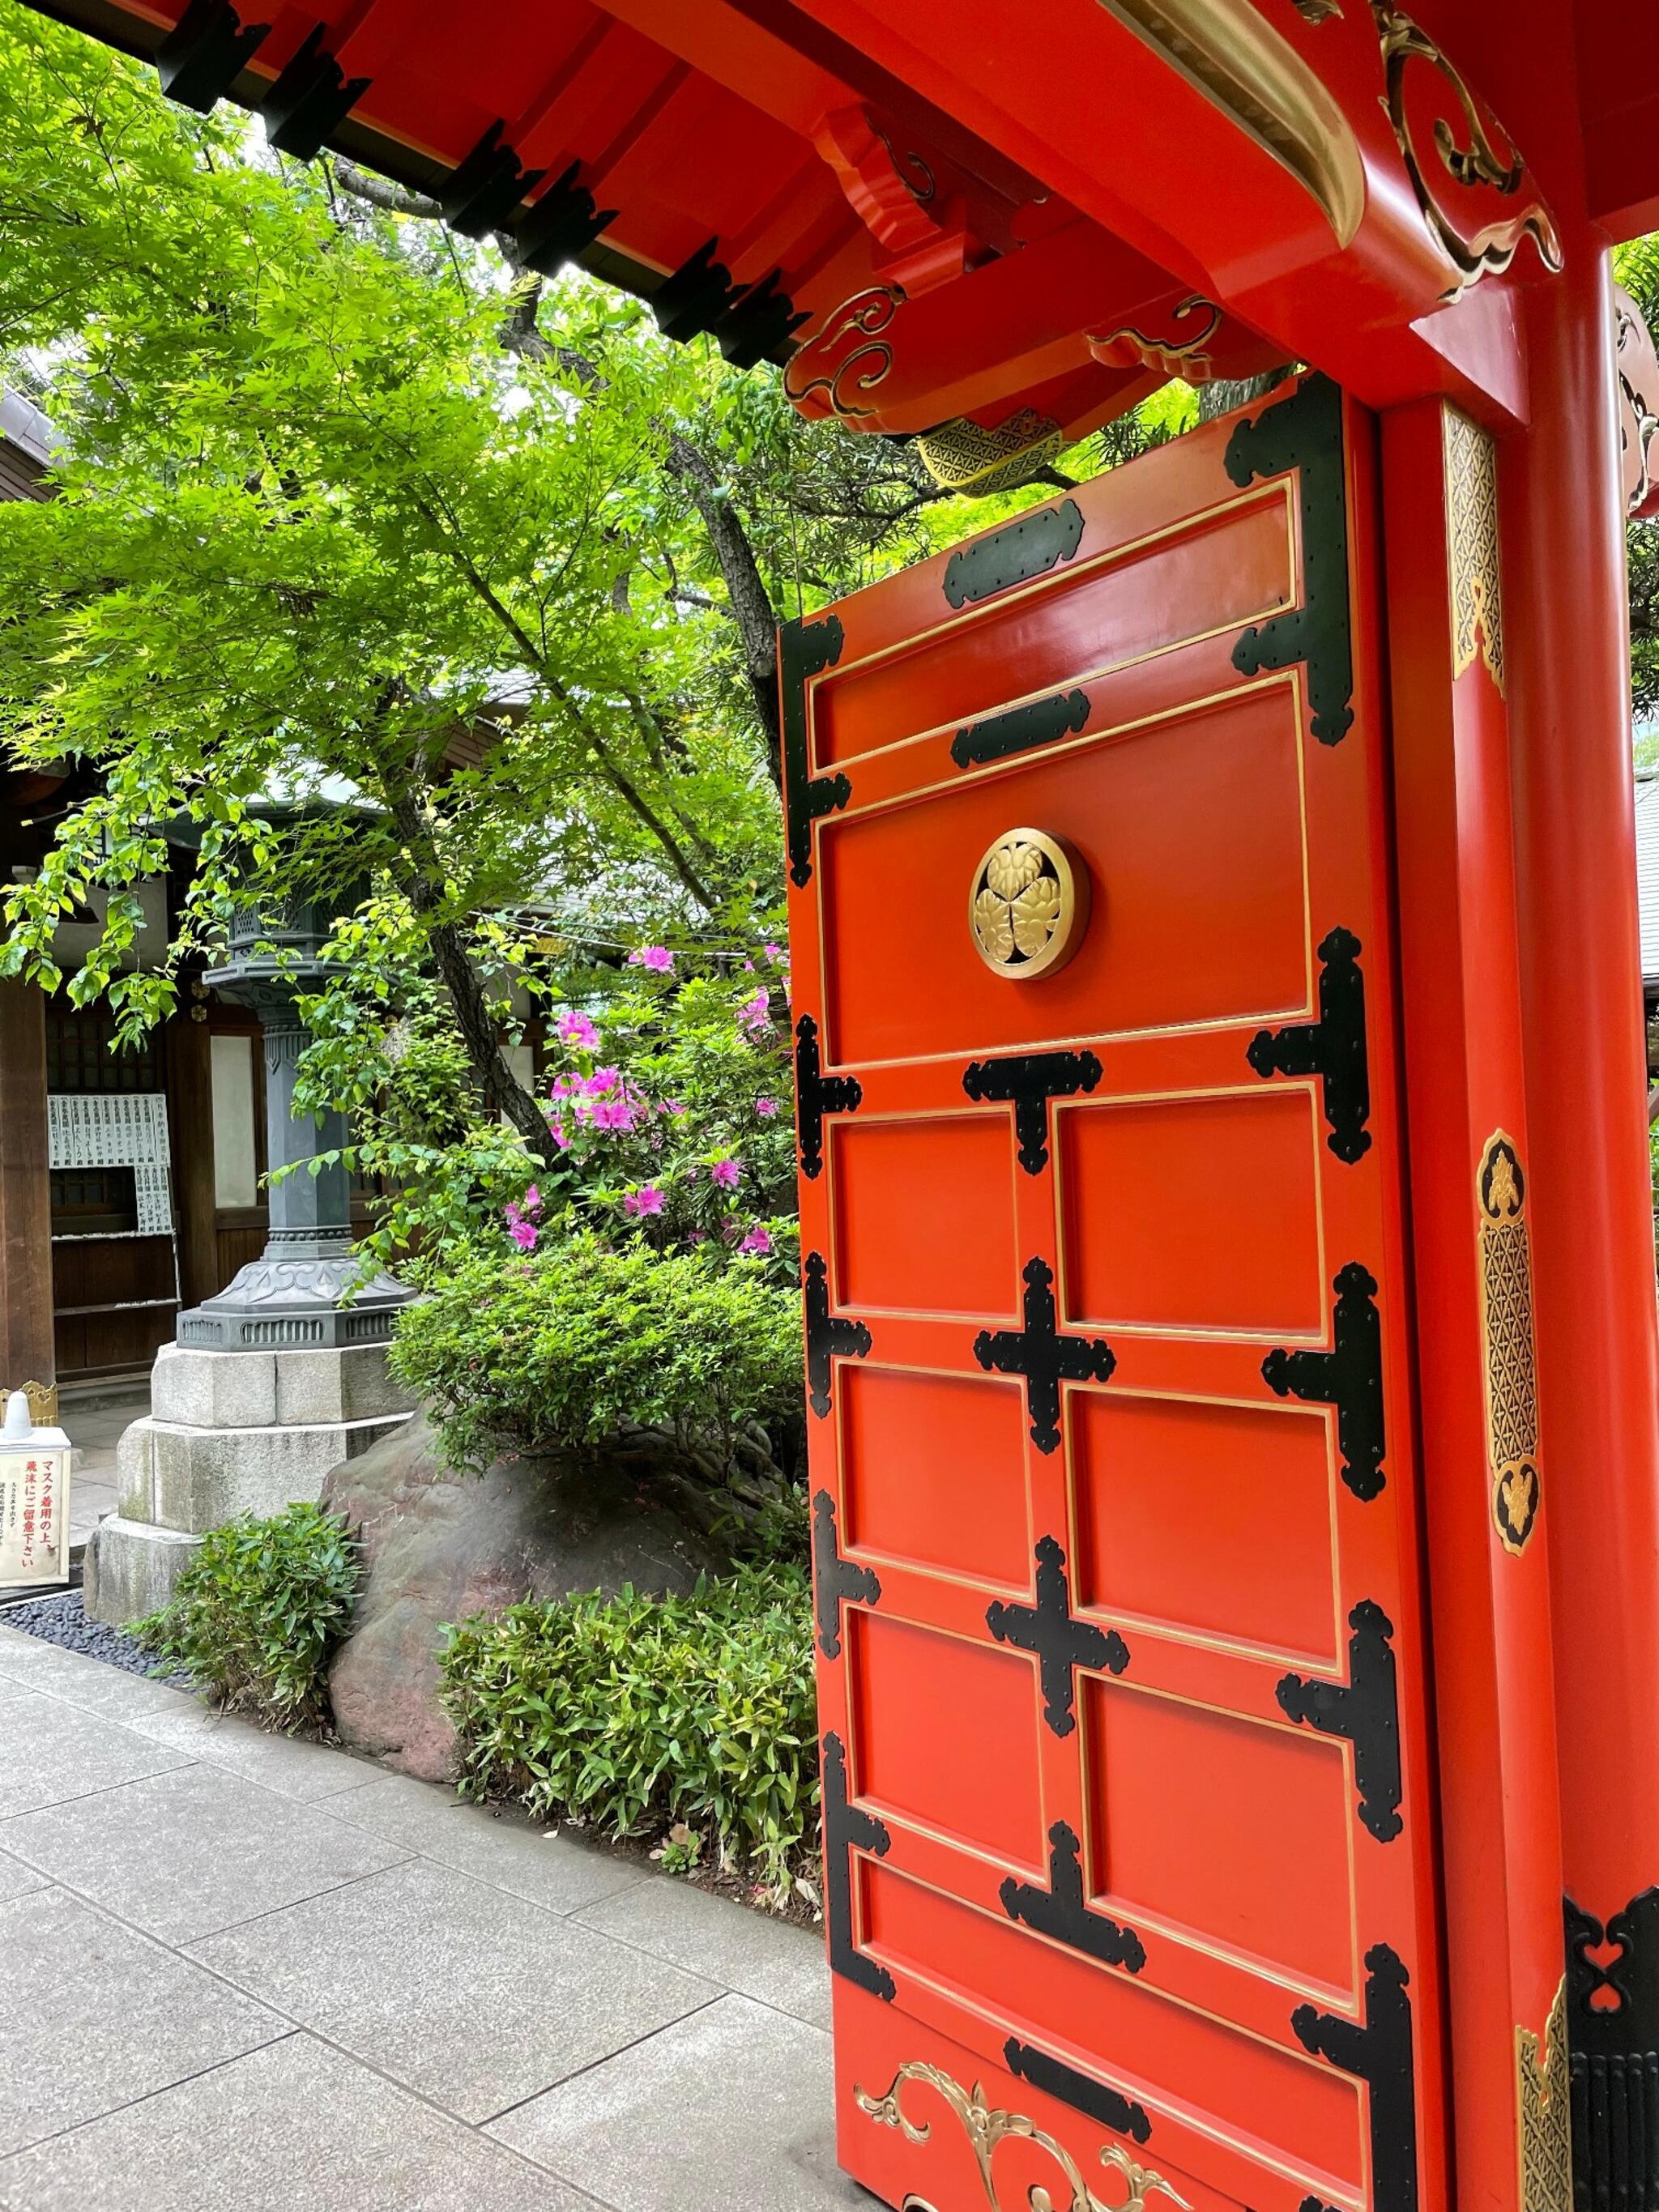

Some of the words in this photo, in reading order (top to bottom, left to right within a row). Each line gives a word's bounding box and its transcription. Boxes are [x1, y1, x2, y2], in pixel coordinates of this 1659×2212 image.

[21, 1461, 37, 1568] 飛沫にご留意下さい
